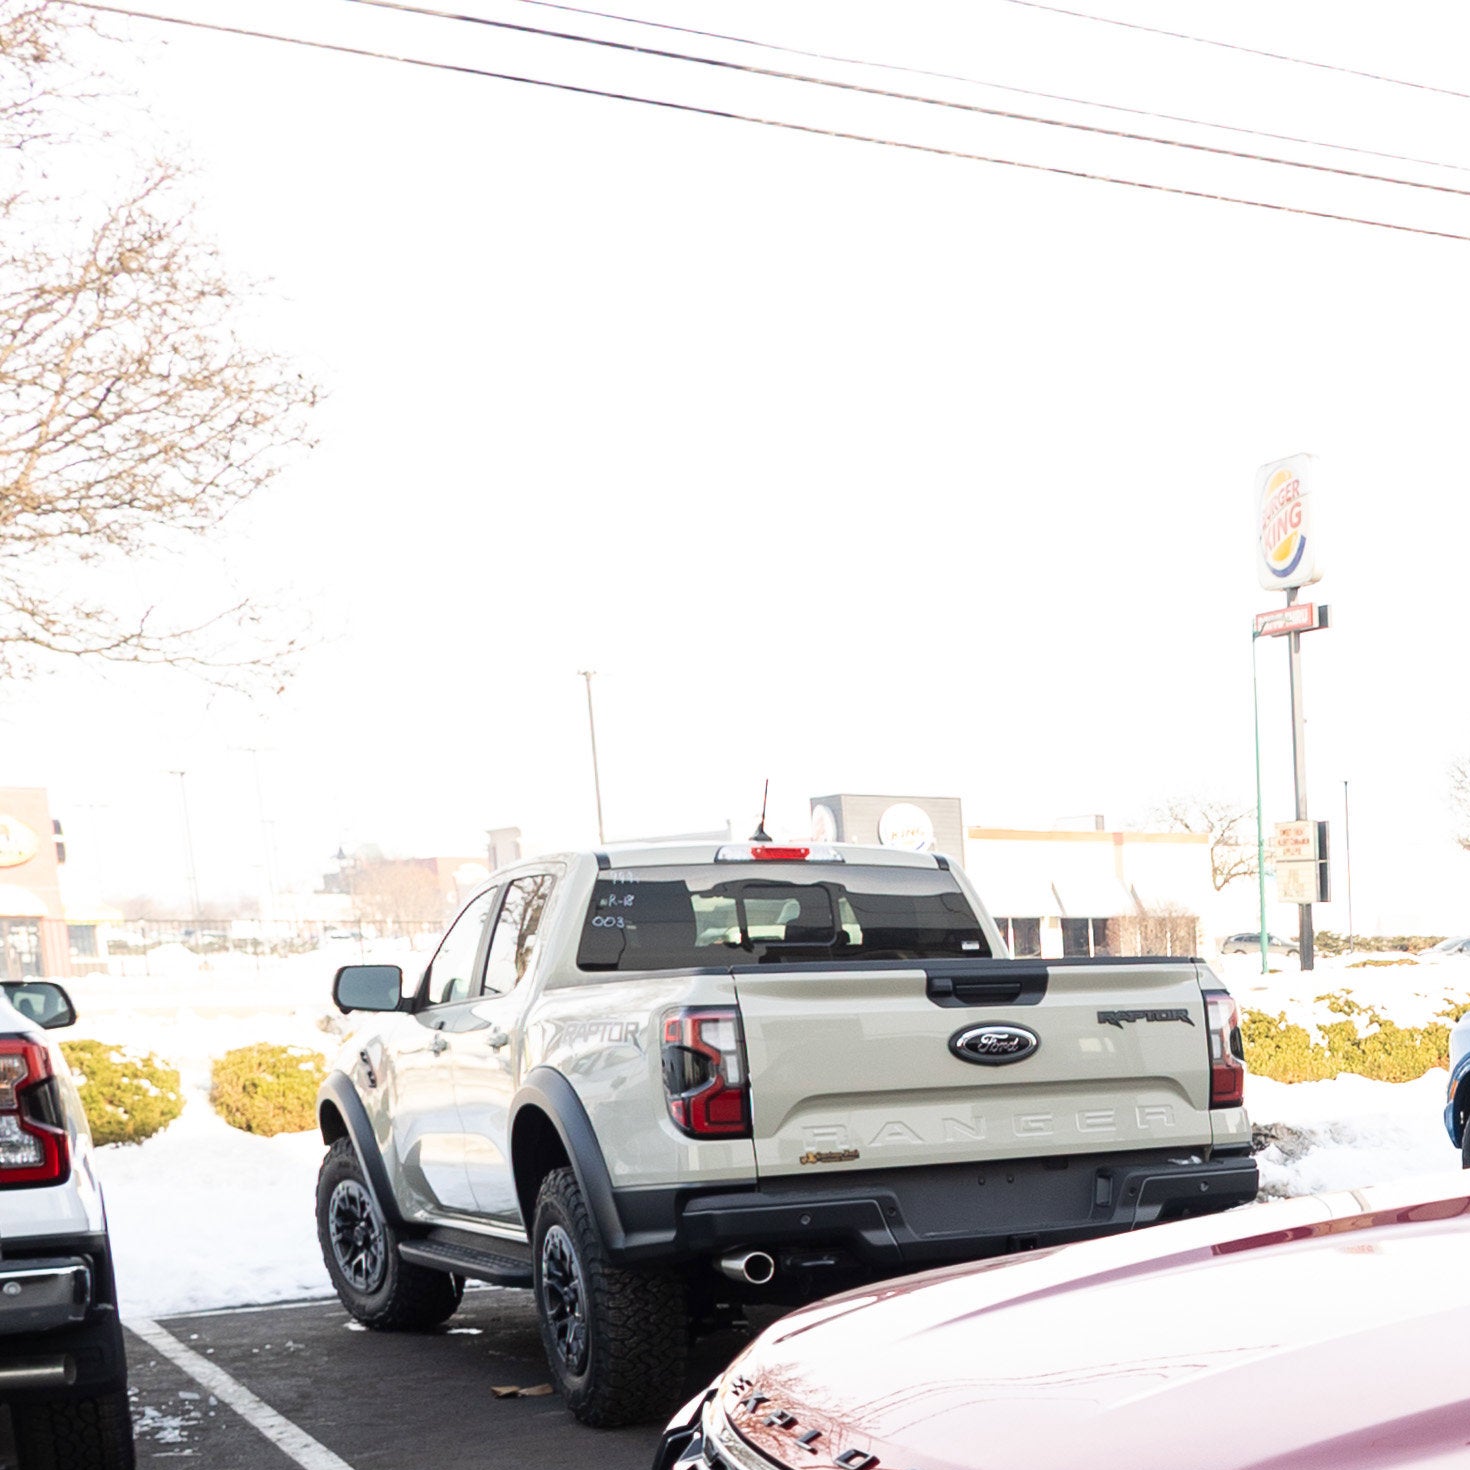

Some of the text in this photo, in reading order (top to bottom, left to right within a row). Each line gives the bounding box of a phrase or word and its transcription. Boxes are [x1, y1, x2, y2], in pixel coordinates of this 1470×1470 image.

[1261, 478, 1300, 530] BURGER
[1264, 501, 1302, 552] KING
[592, 915, 625, 928] 003
[1097, 1008, 1195, 1030] RAPTOR
[560, 1021, 646, 1056] RAPTOR
[977, 1033, 1019, 1053] Ford
[801, 1104, 1176, 1150] RANGER
